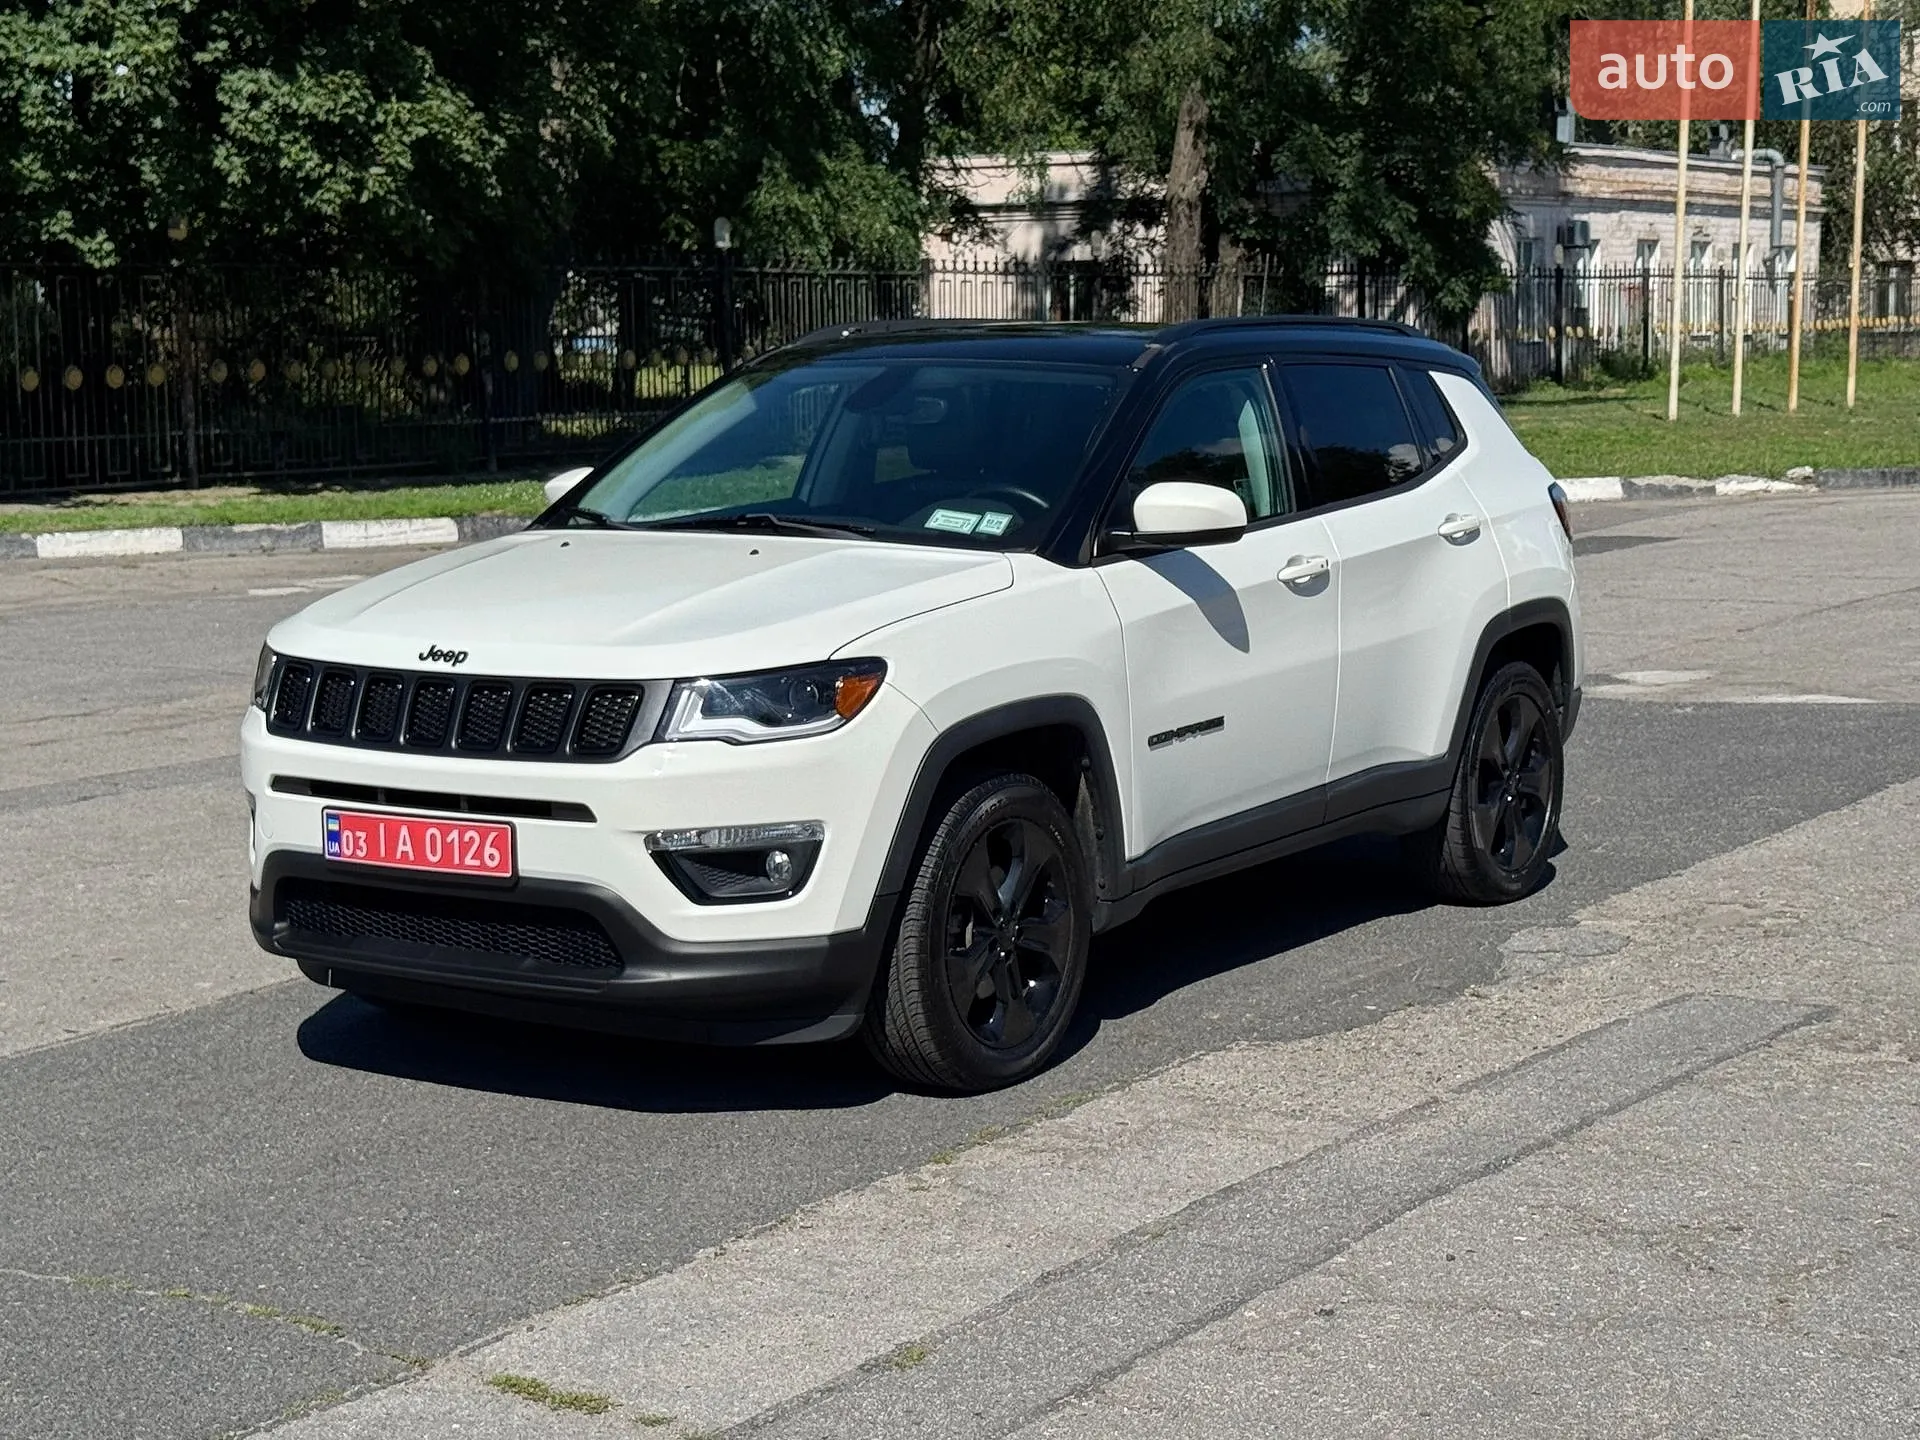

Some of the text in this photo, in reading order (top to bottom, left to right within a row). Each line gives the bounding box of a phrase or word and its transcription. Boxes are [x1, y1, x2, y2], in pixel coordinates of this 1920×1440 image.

[418, 644, 469, 668] Jeep
[328, 840, 341, 854] UA
[425, 827, 501, 869] 0126
